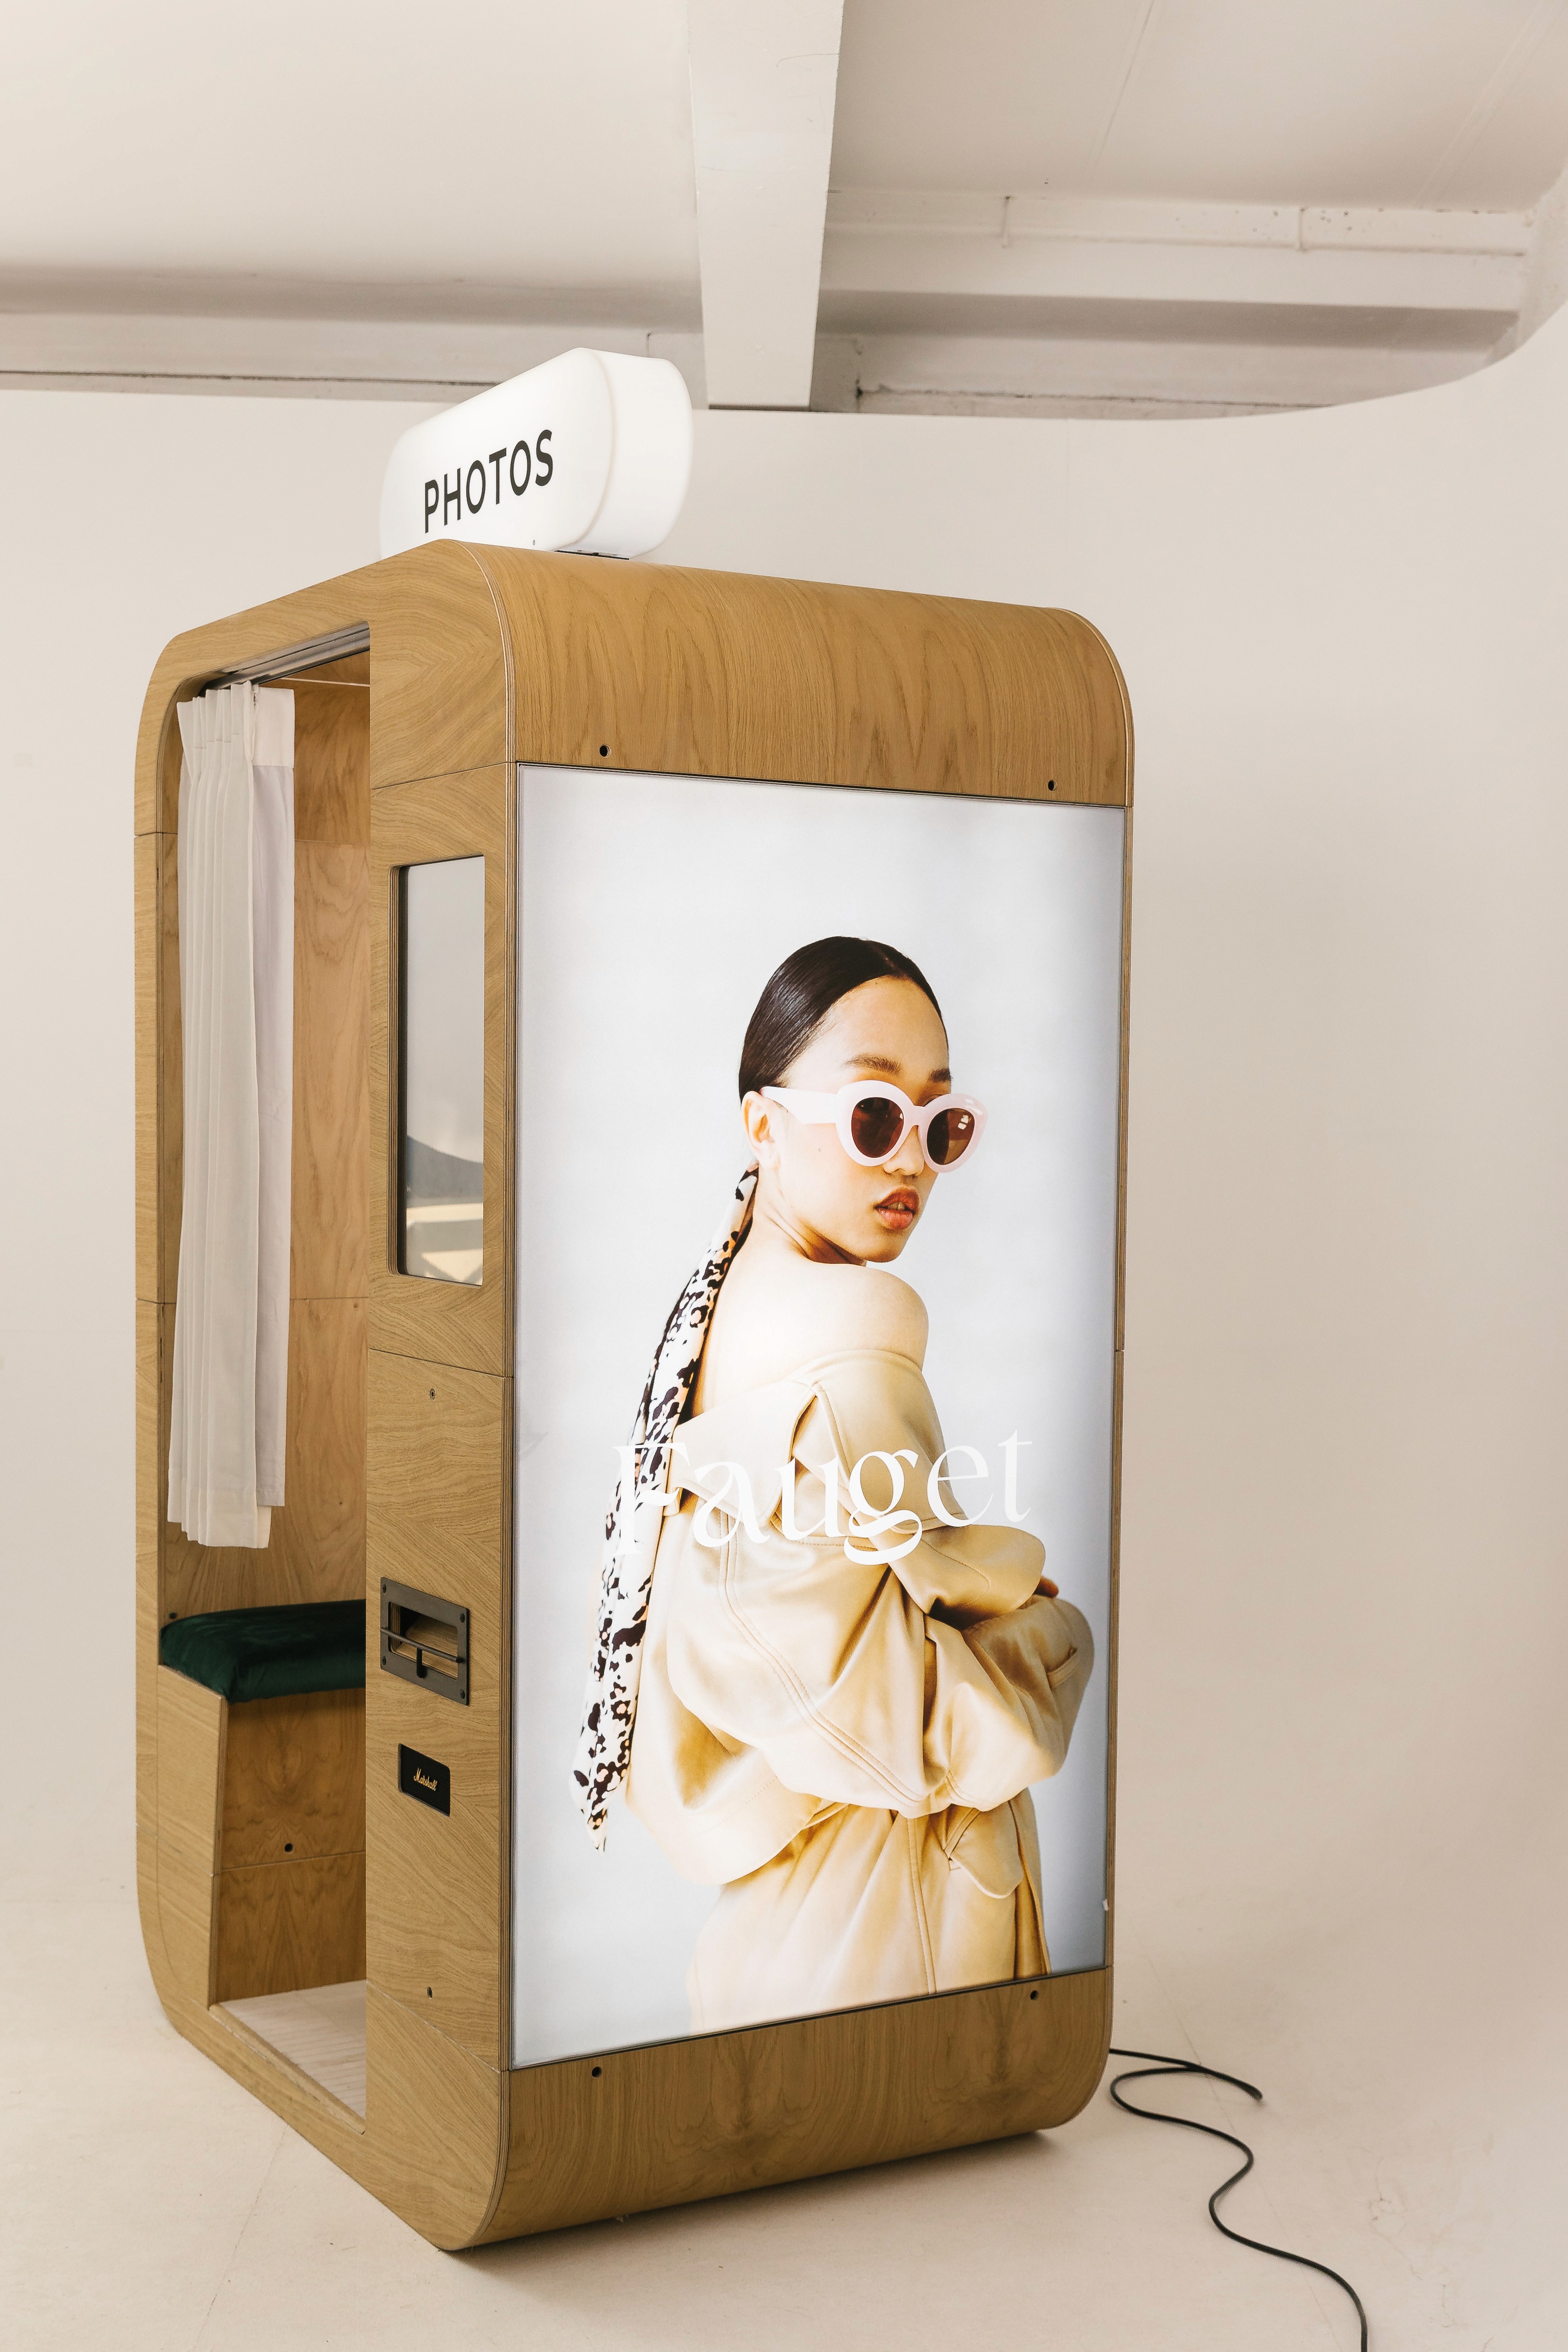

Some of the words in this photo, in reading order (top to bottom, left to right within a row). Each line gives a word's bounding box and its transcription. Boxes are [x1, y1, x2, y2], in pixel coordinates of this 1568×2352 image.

[425, 429, 553, 533] PHOTOS
[612, 1429, 1033, 1565] Fauget
[414, 1768, 438, 1791] Marshall
